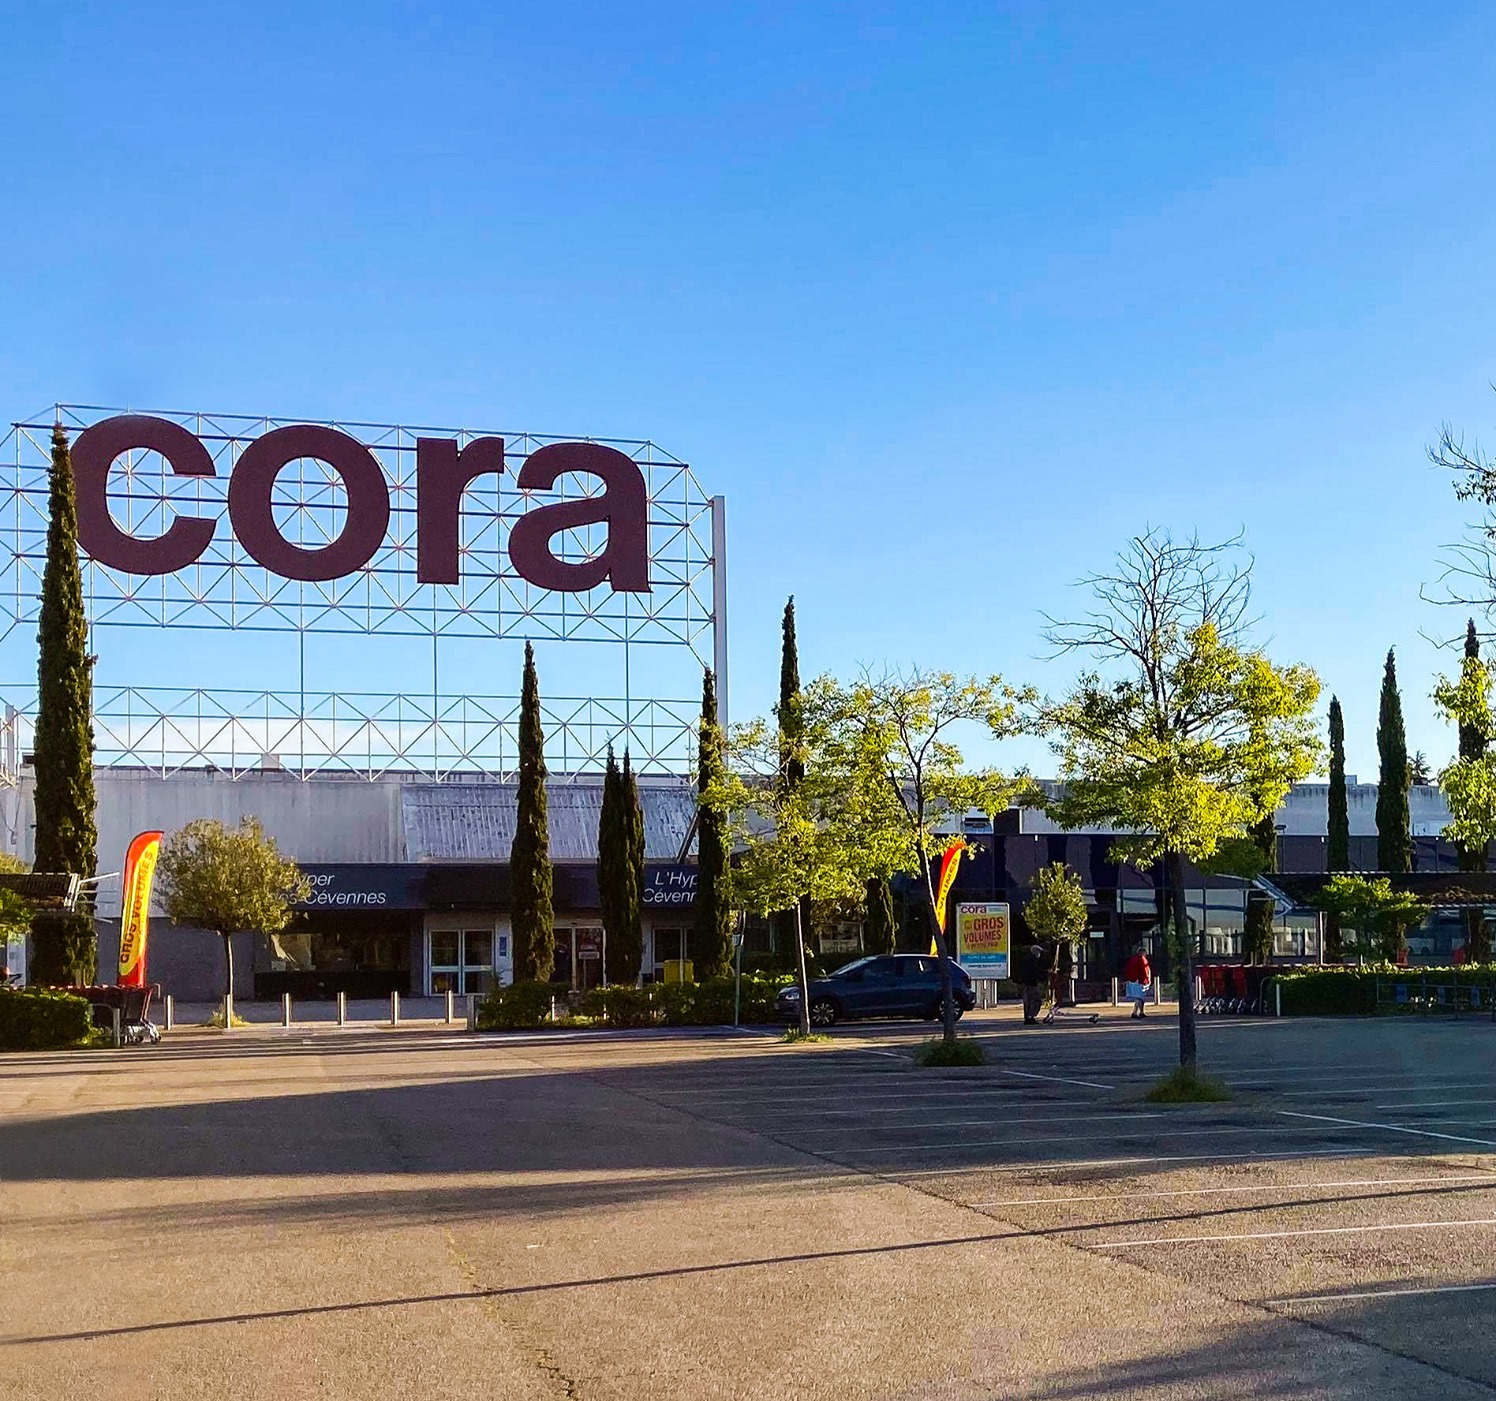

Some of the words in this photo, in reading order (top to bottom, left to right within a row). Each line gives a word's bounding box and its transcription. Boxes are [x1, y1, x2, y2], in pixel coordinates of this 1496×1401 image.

[70, 414, 653, 593] cora
[655, 871, 698, 889] L'Hyp
[642, 888, 697, 903] Céven
[961, 906, 987, 914] cora
[973, 916, 1004, 931] GROS
[120, 925, 137, 963] GROS
[963, 930, 1002, 943] VOLUMES
